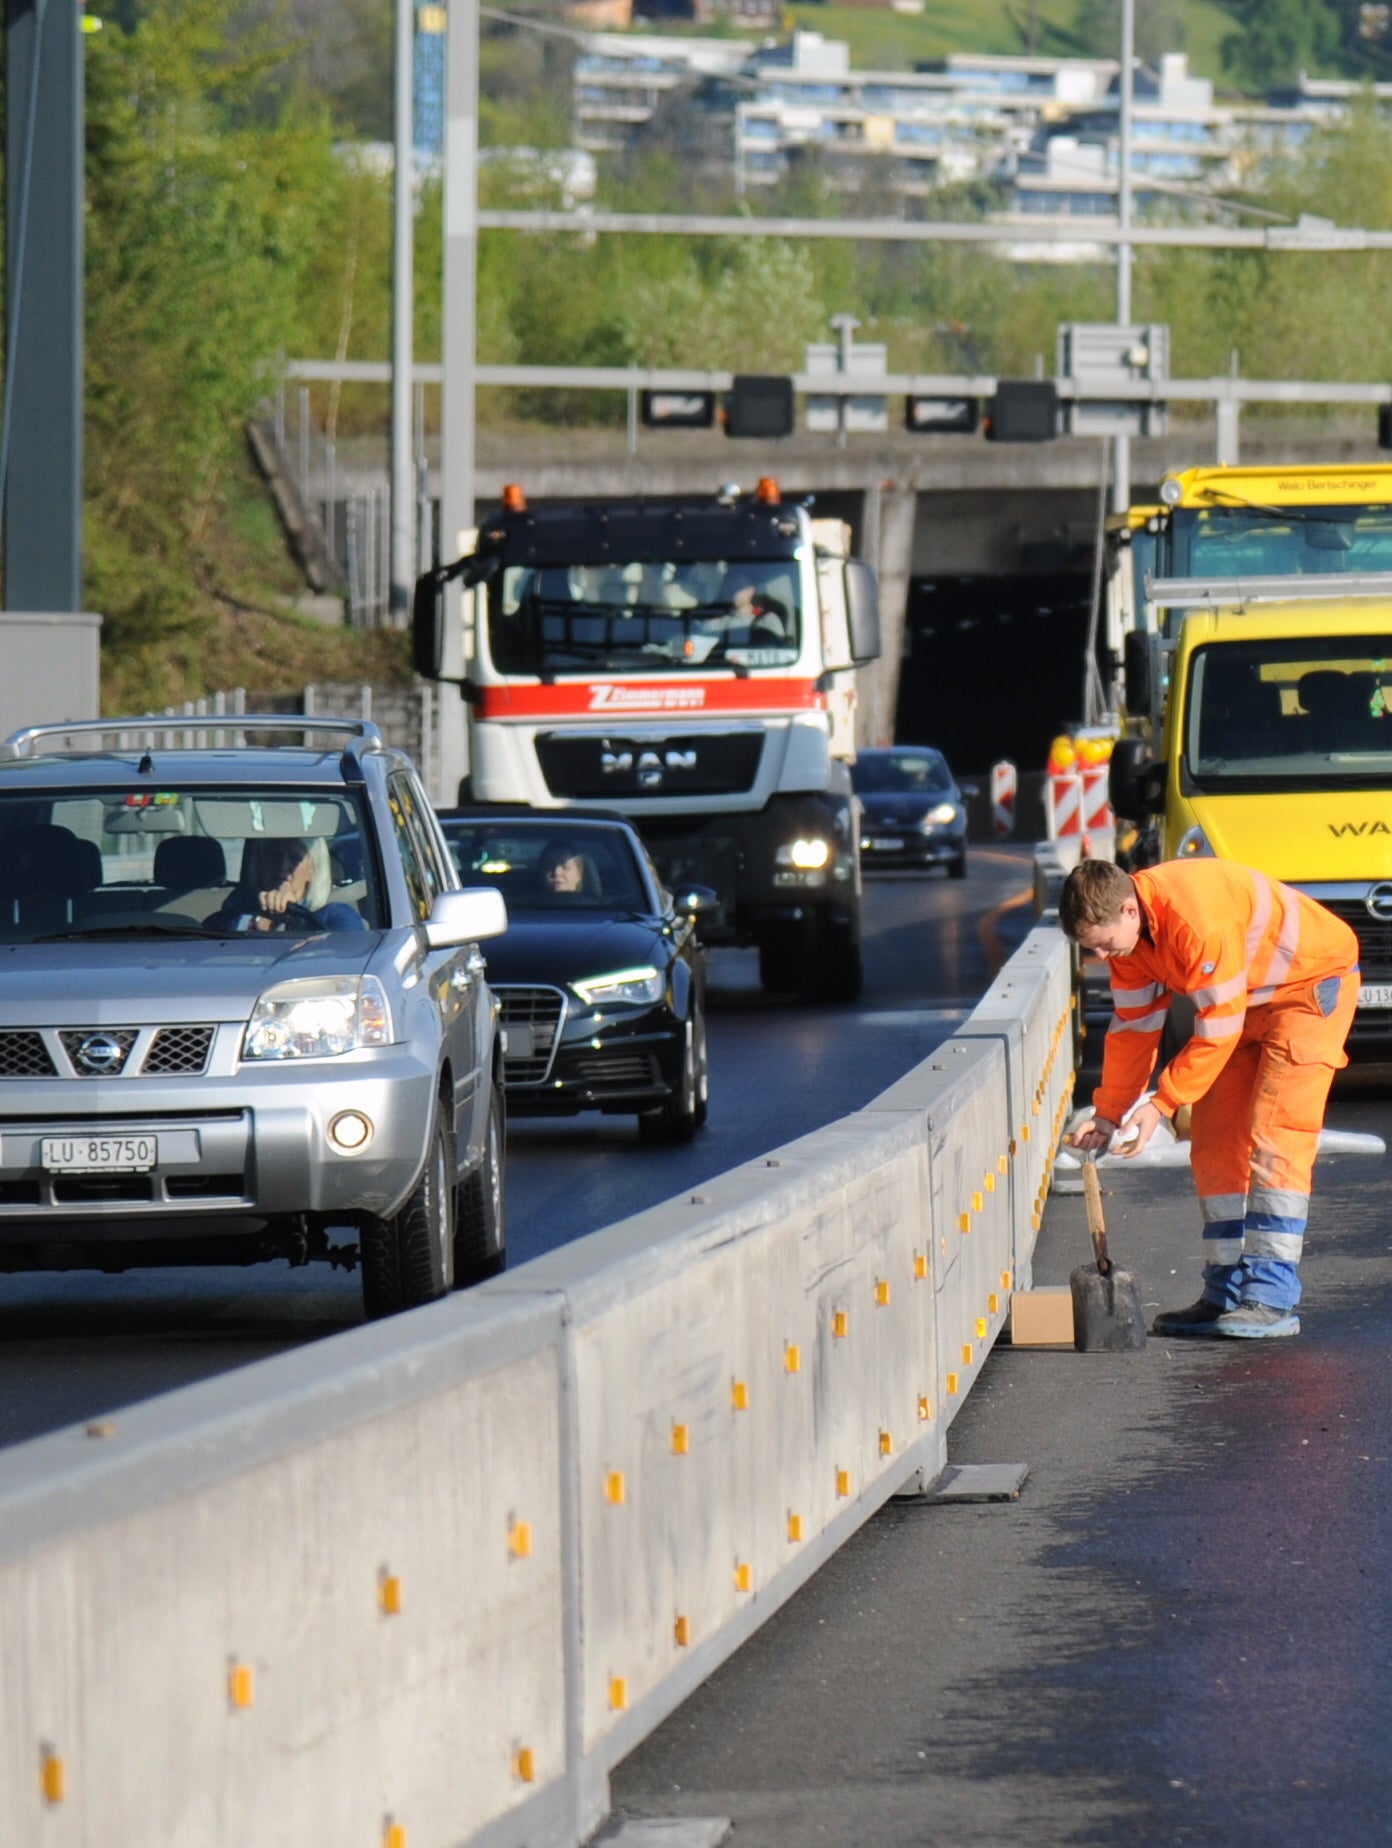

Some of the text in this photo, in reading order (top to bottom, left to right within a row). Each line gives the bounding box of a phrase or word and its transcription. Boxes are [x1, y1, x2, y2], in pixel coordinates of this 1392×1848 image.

[601, 752, 697, 771] MAN
[50, 1140, 149, 1162] LU 85750
